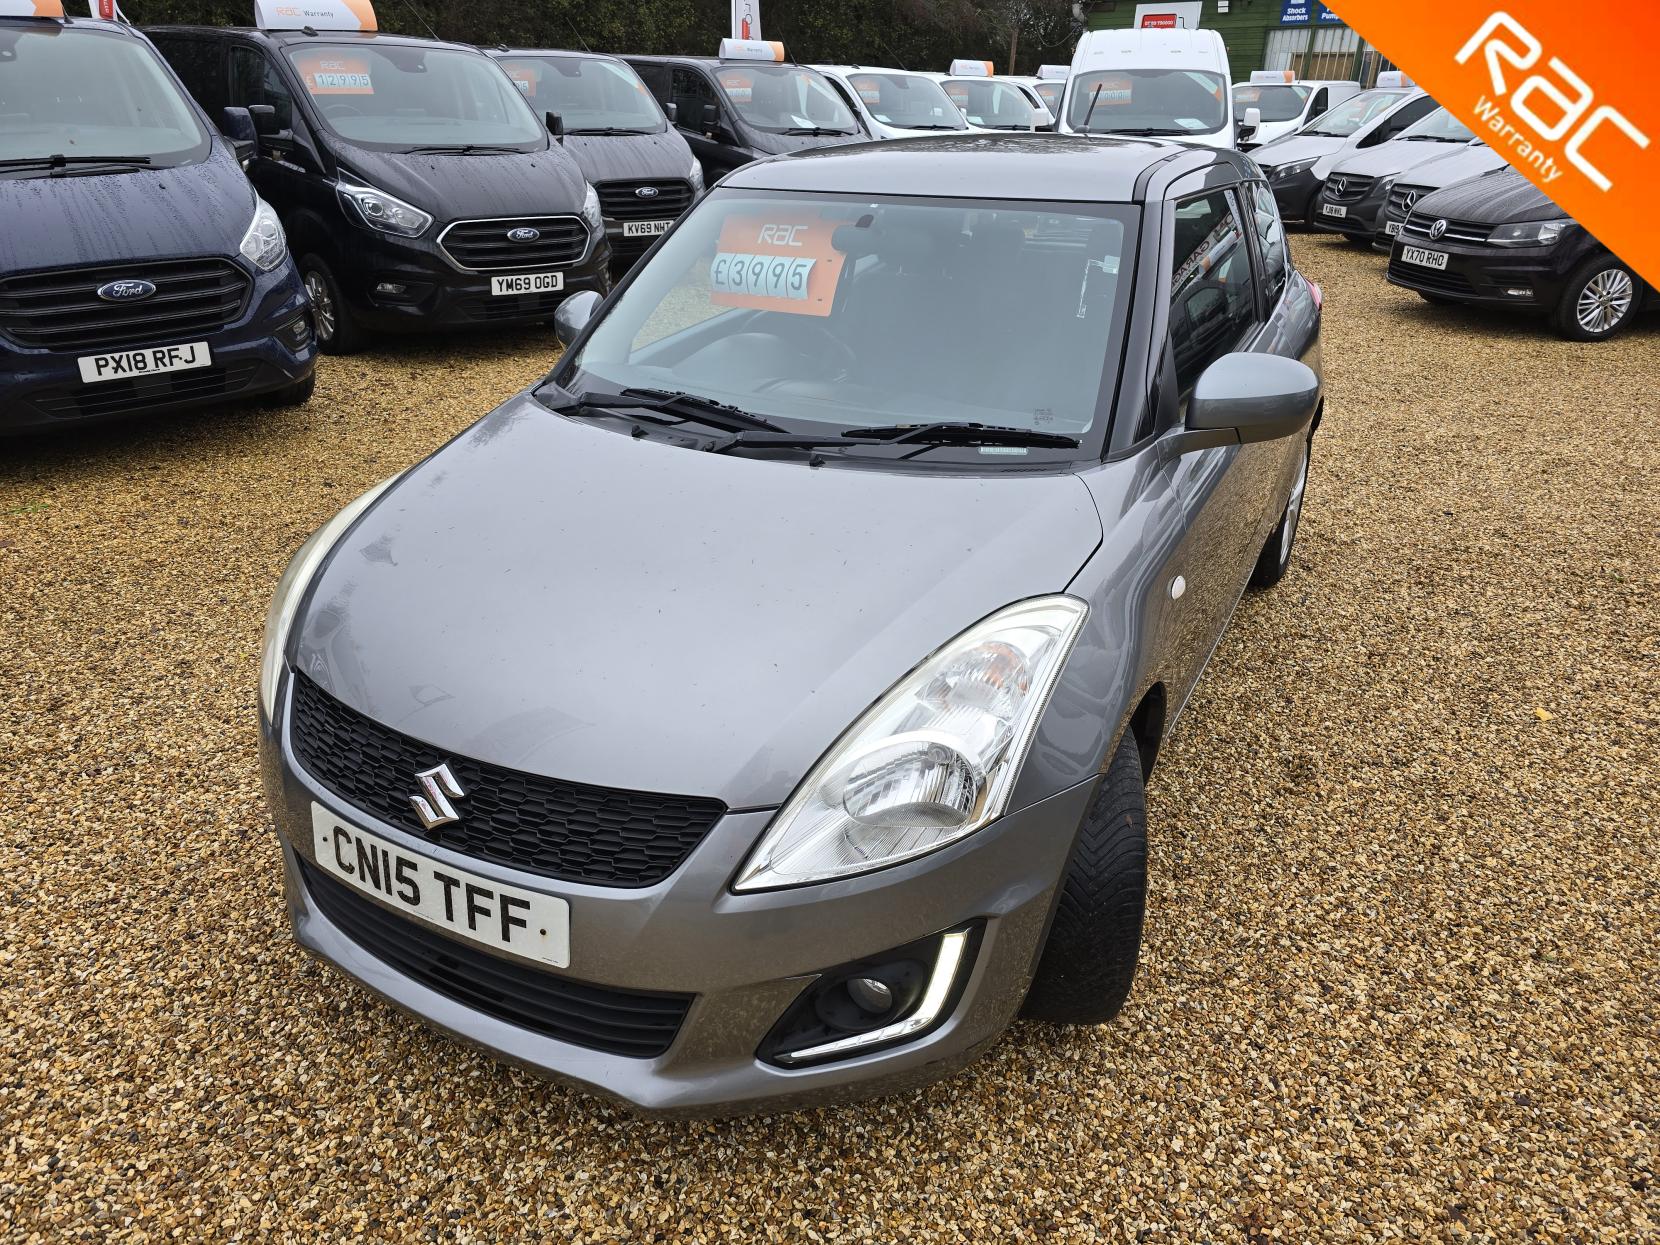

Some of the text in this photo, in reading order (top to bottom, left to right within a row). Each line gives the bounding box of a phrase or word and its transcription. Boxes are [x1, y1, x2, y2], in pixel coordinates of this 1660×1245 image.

[304, 10, 334, 18] Warranty
[516, 229, 535, 239] Ford
[627, 223, 652, 235] KV69
[1406, 247, 1445, 267] YX70 RHO
[497, 274, 558, 293] YM69 OGD
[714, 258, 808, 291] £3995
[112, 282, 144, 297] Ford
[94, 345, 197, 376] PX18 RFJ
[332, 825, 532, 943] CN15 TFF
